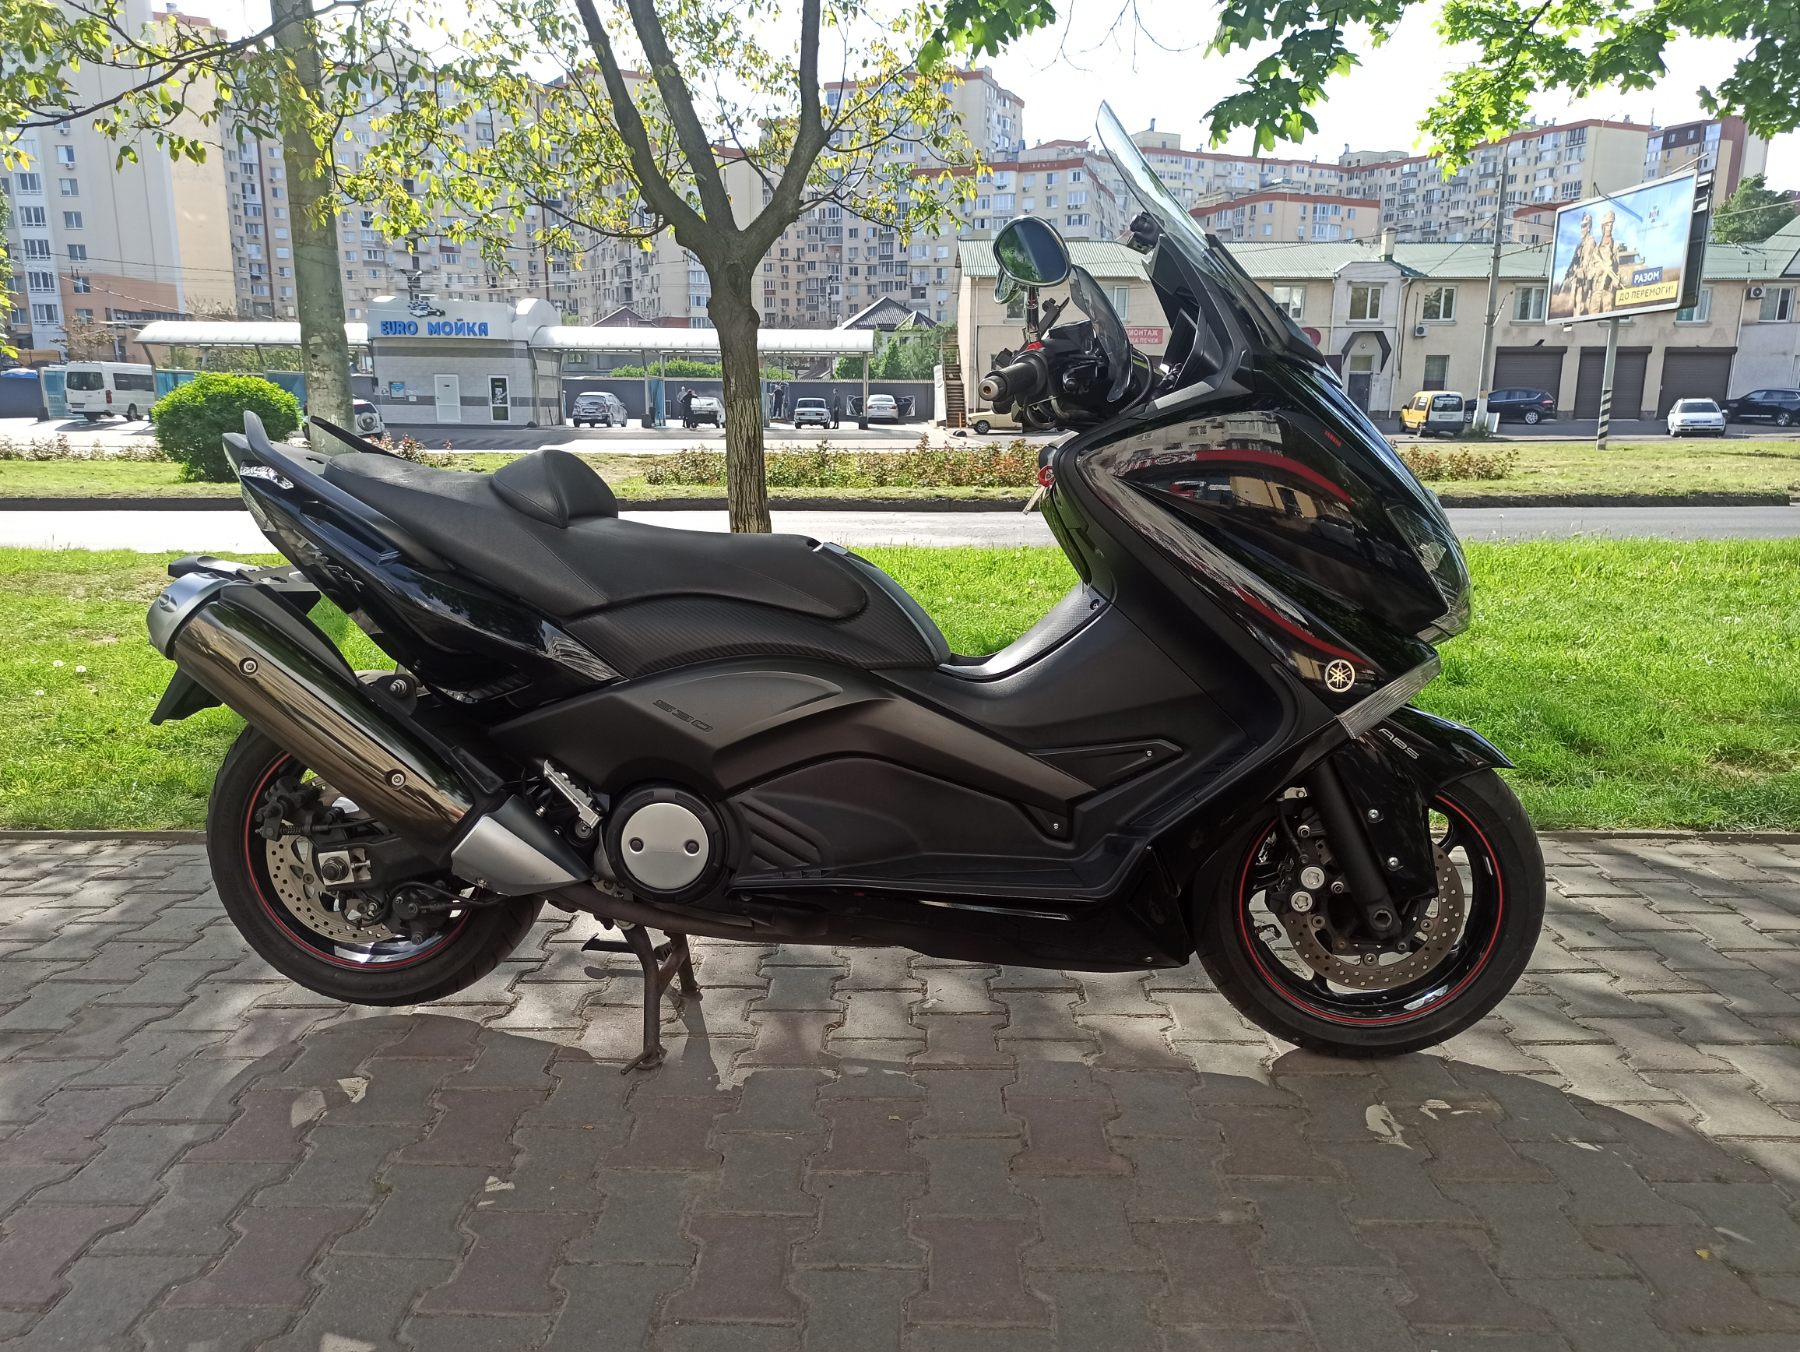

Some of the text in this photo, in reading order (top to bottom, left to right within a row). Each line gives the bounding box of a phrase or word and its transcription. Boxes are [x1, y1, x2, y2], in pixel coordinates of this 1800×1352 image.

[1634, 270, 1660, 284] РАЗОМ
[1618, 285, 1674, 302] ДО ПЕРЕМОГИ!
[380, 318, 488, 336] EURO МОЙКА
[652, 699, 713, 732] 530
[1378, 728, 1419, 759] ABS
